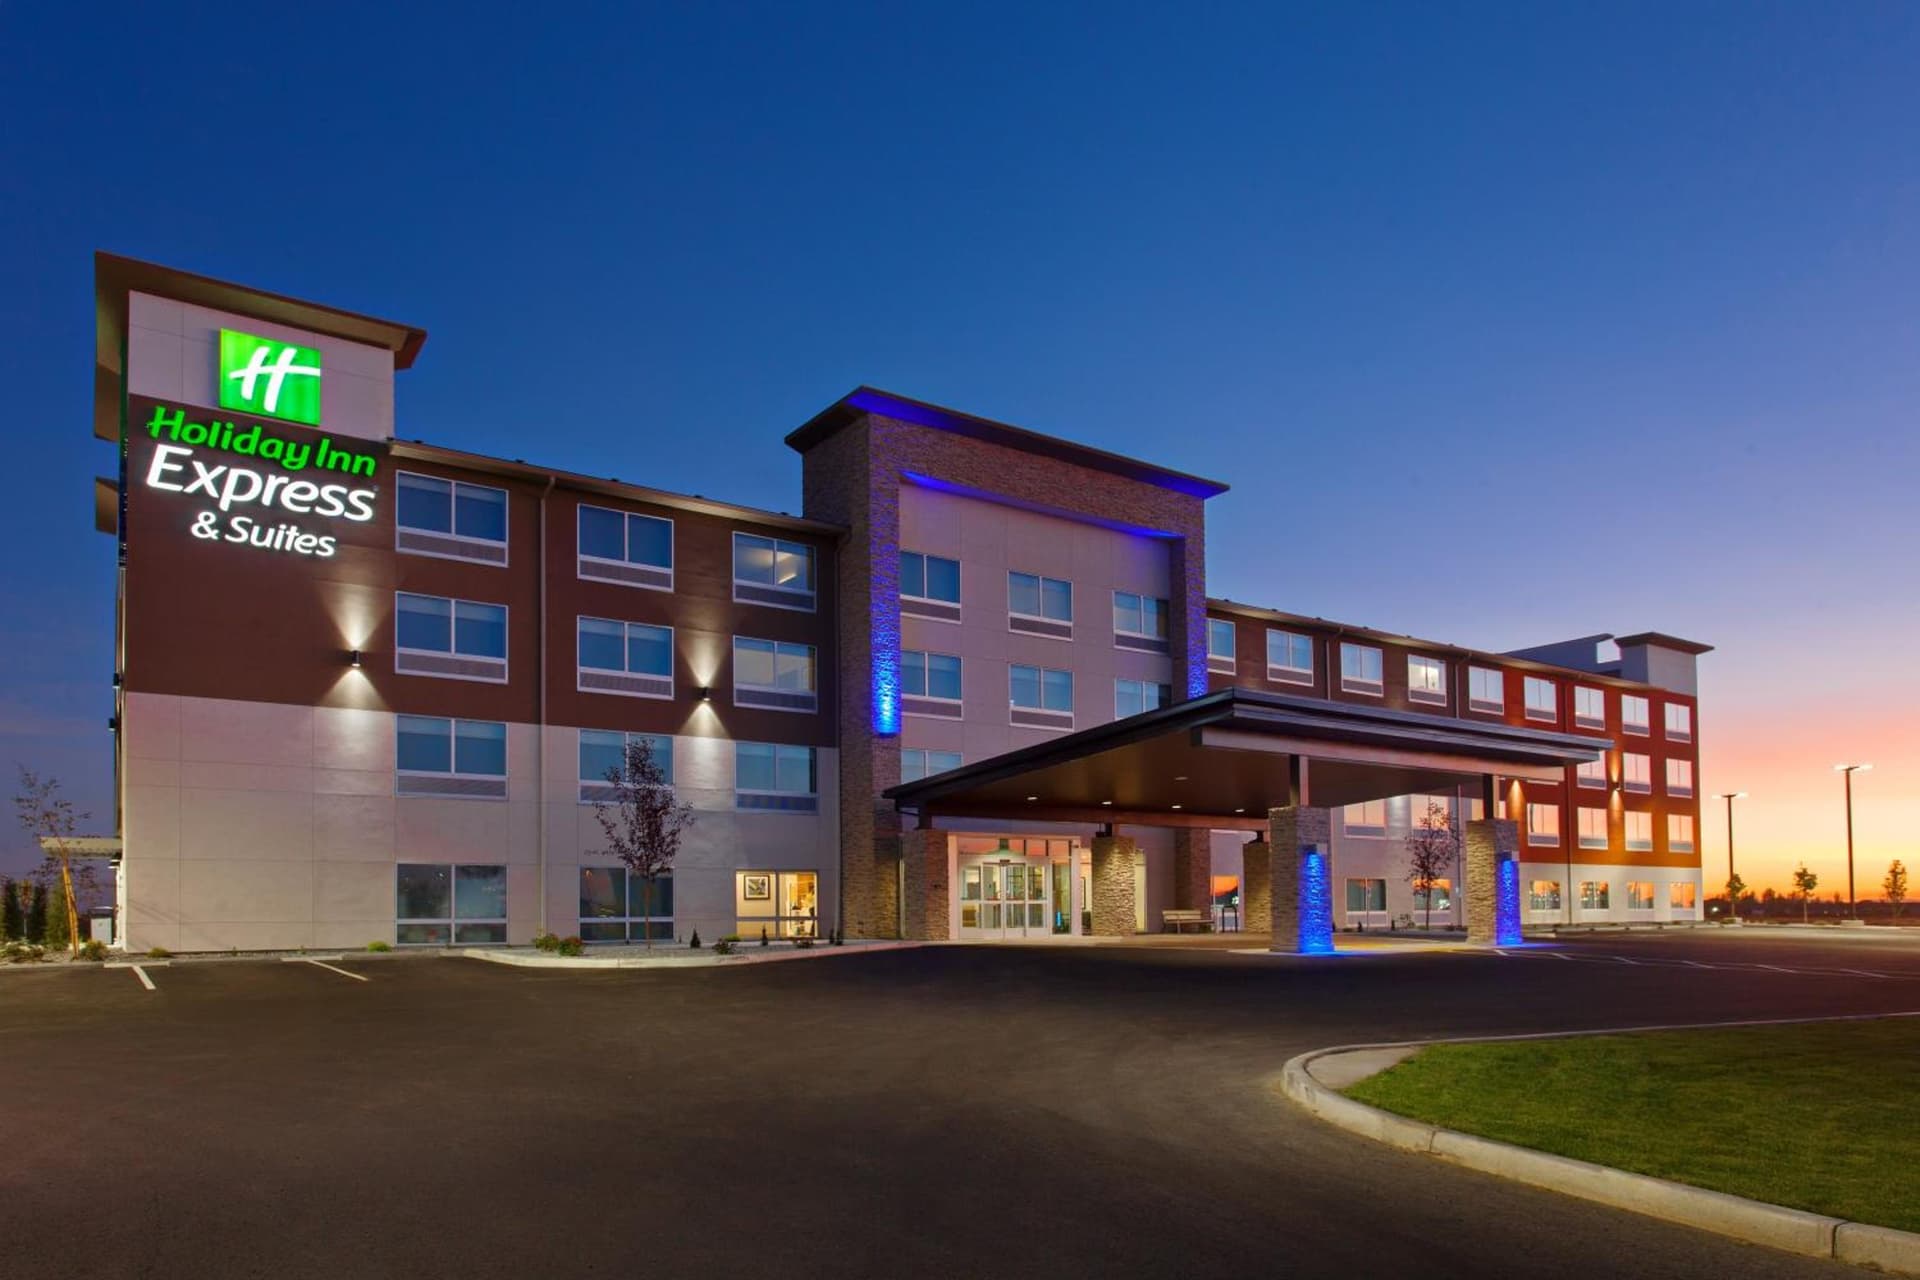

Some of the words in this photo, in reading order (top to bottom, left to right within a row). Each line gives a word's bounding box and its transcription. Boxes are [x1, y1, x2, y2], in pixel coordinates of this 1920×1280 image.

[146, 406, 311, 470] Holiday
[316, 438, 376, 477] Inn
[146, 443, 376, 522] Express
[191, 511, 219, 540] &
[224, 516, 336, 557] Suites
